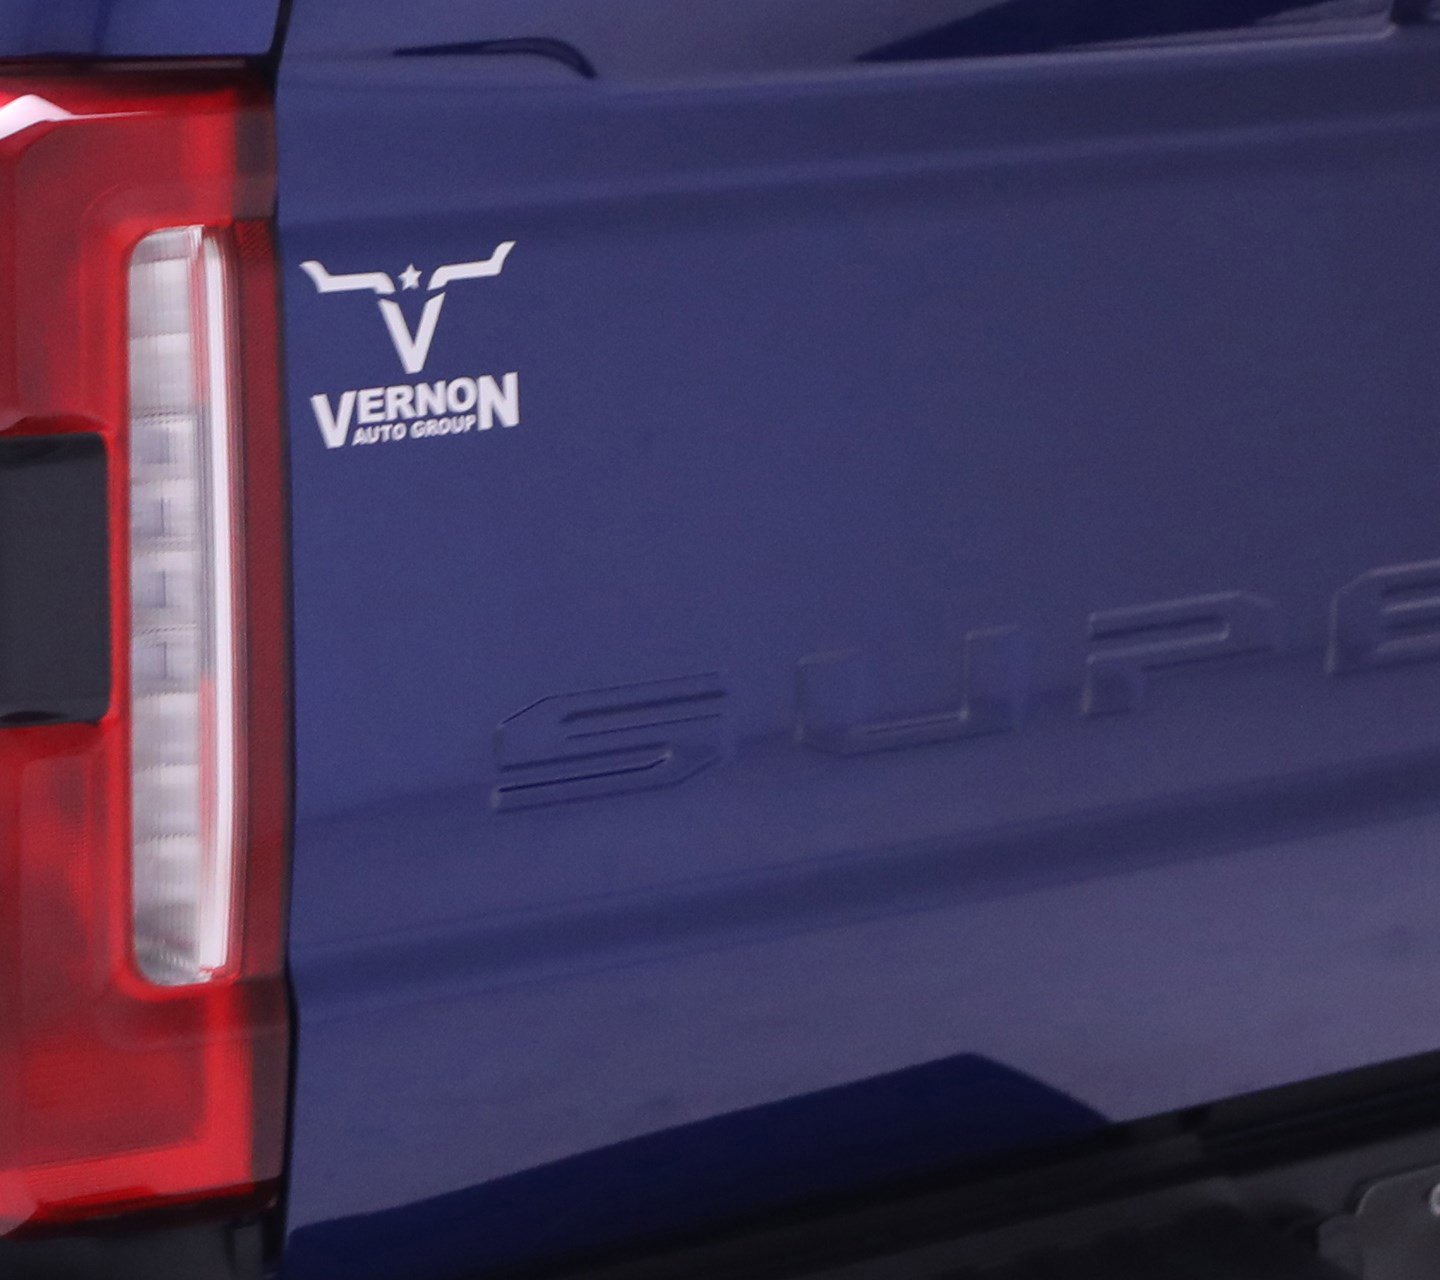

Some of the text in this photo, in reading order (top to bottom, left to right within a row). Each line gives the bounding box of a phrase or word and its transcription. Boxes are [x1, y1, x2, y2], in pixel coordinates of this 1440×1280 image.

[310, 371, 519, 450] VERNON
[351, 414, 477, 446] AUTO GROUP
